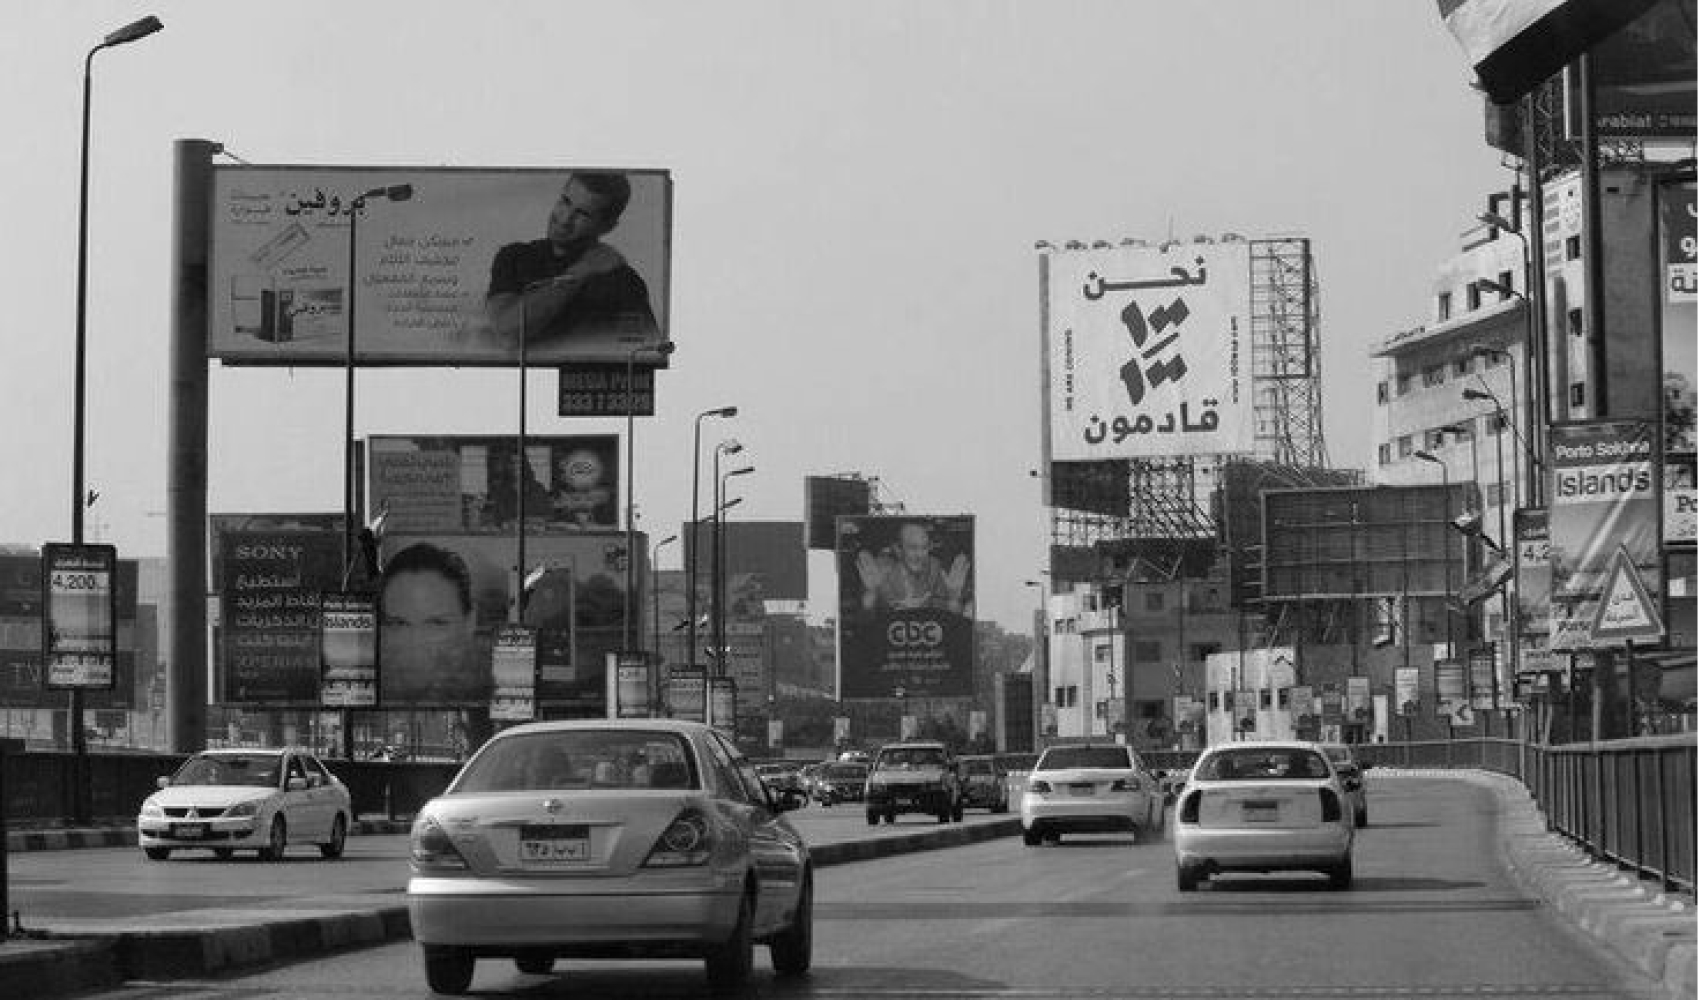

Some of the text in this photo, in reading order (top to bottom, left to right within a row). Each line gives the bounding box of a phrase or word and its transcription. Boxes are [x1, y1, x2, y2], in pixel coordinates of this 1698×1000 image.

[1083, 255, 1206, 301] نحن
[1084, 398, 1220, 444] قادمون
[1557, 468, 1650, 497] Islands
[236, 545, 303, 560] SONY
